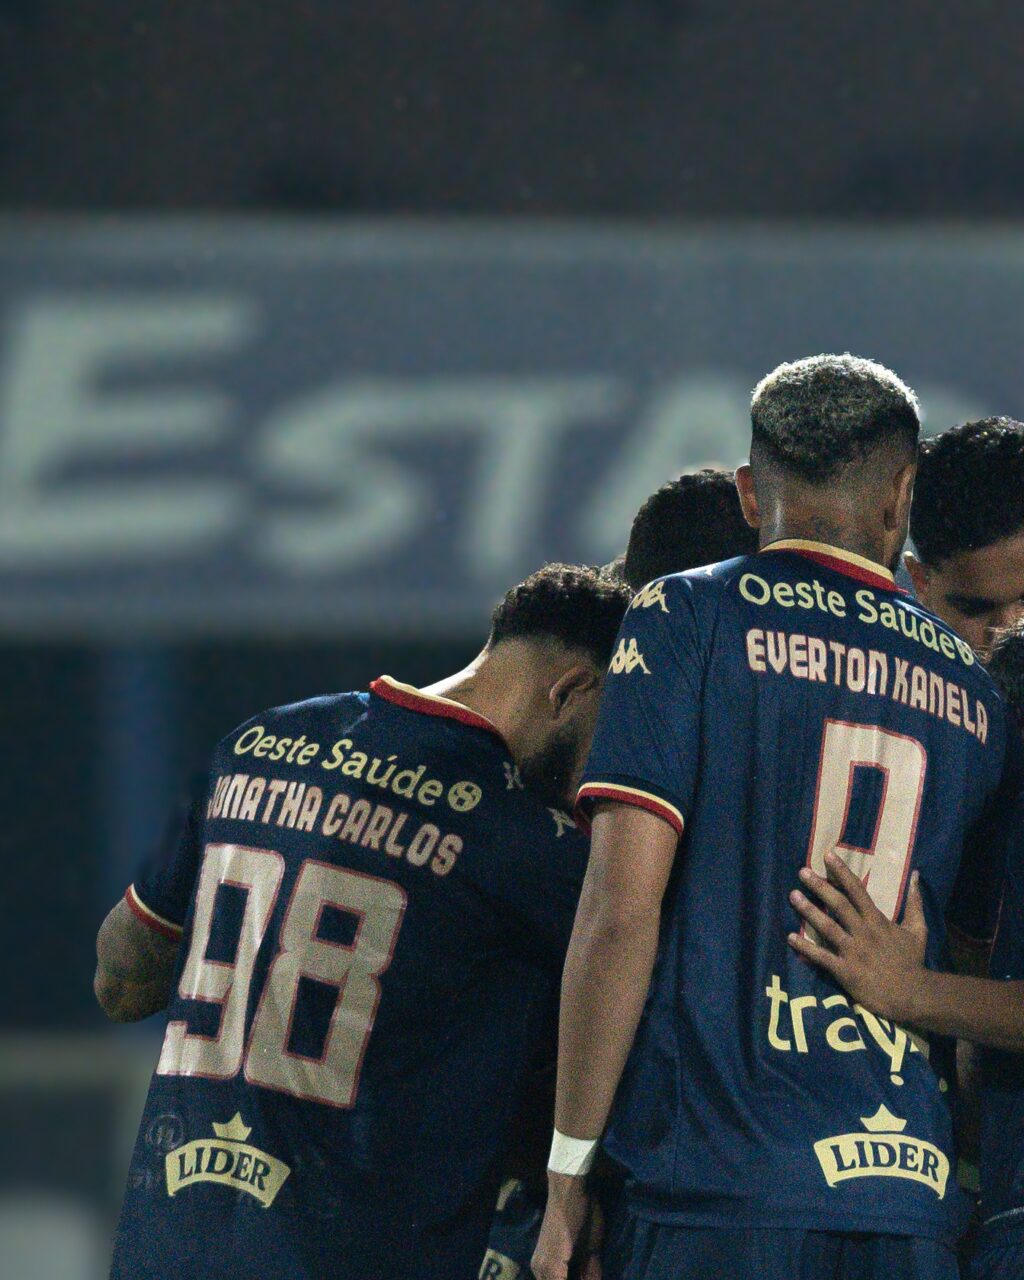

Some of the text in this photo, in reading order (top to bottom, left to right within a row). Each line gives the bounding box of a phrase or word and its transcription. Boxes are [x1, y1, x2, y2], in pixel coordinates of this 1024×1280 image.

[738, 573, 847, 618] Oeste
[746, 628, 988, 745] EVERTON KANELA
[234, 726, 444, 806] Oeste Saúde
[321, 792, 464, 877] CARLOS
[155, 841, 408, 1110] 98
[177, 1146, 271, 1191] LIDER
[829, 1140, 940, 1183] LIDER
